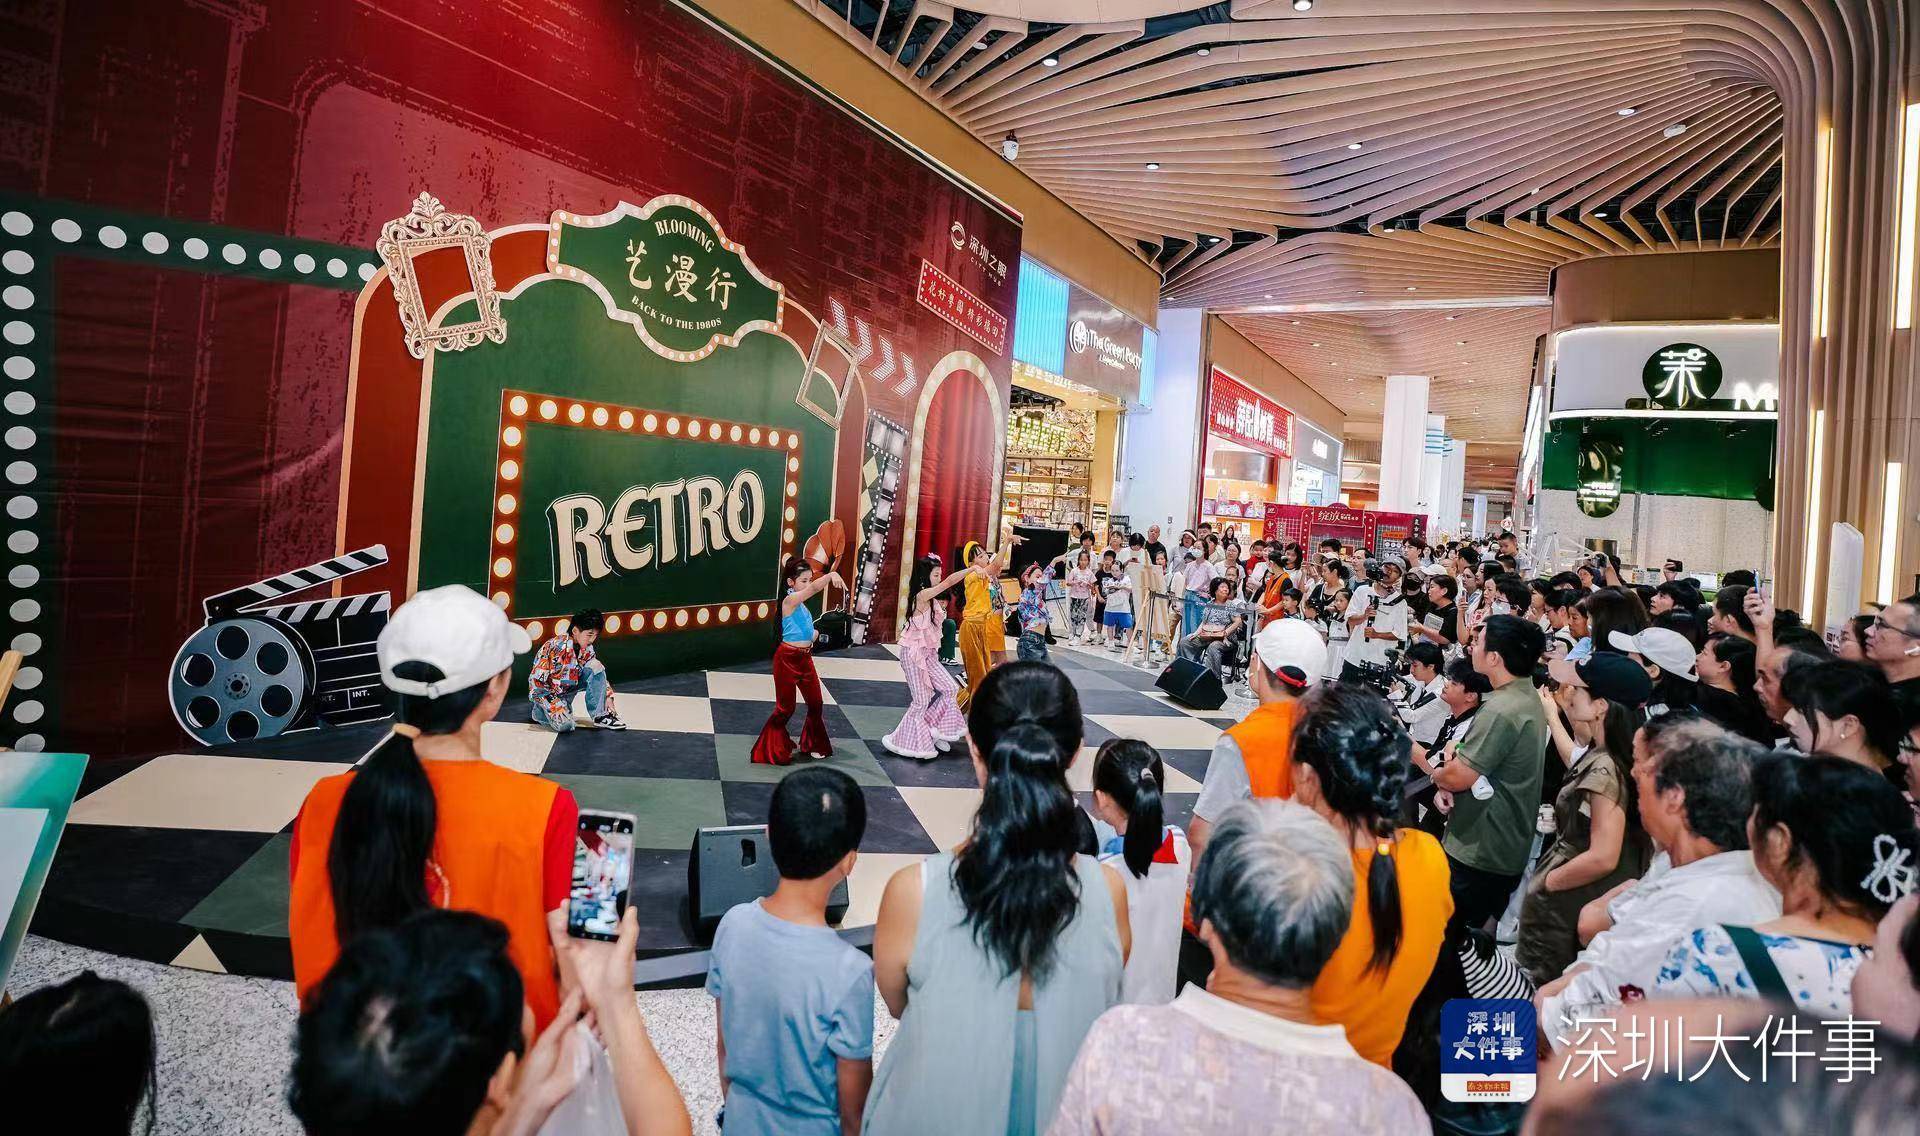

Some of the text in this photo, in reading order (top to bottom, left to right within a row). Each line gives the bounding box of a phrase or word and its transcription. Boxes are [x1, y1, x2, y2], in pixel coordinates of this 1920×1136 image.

[655, 219, 715, 253] BLOOMING
[625, 239, 737, 311] 艺漫行
[968, 234, 1007, 279] 深圳之眼
[631, 295, 658, 319] BACK
[660, 313, 673, 326] TO
[675, 318, 695, 330] THE
[546, 468, 765, 594] RETRO
[352, 689, 370, 698] INT.
